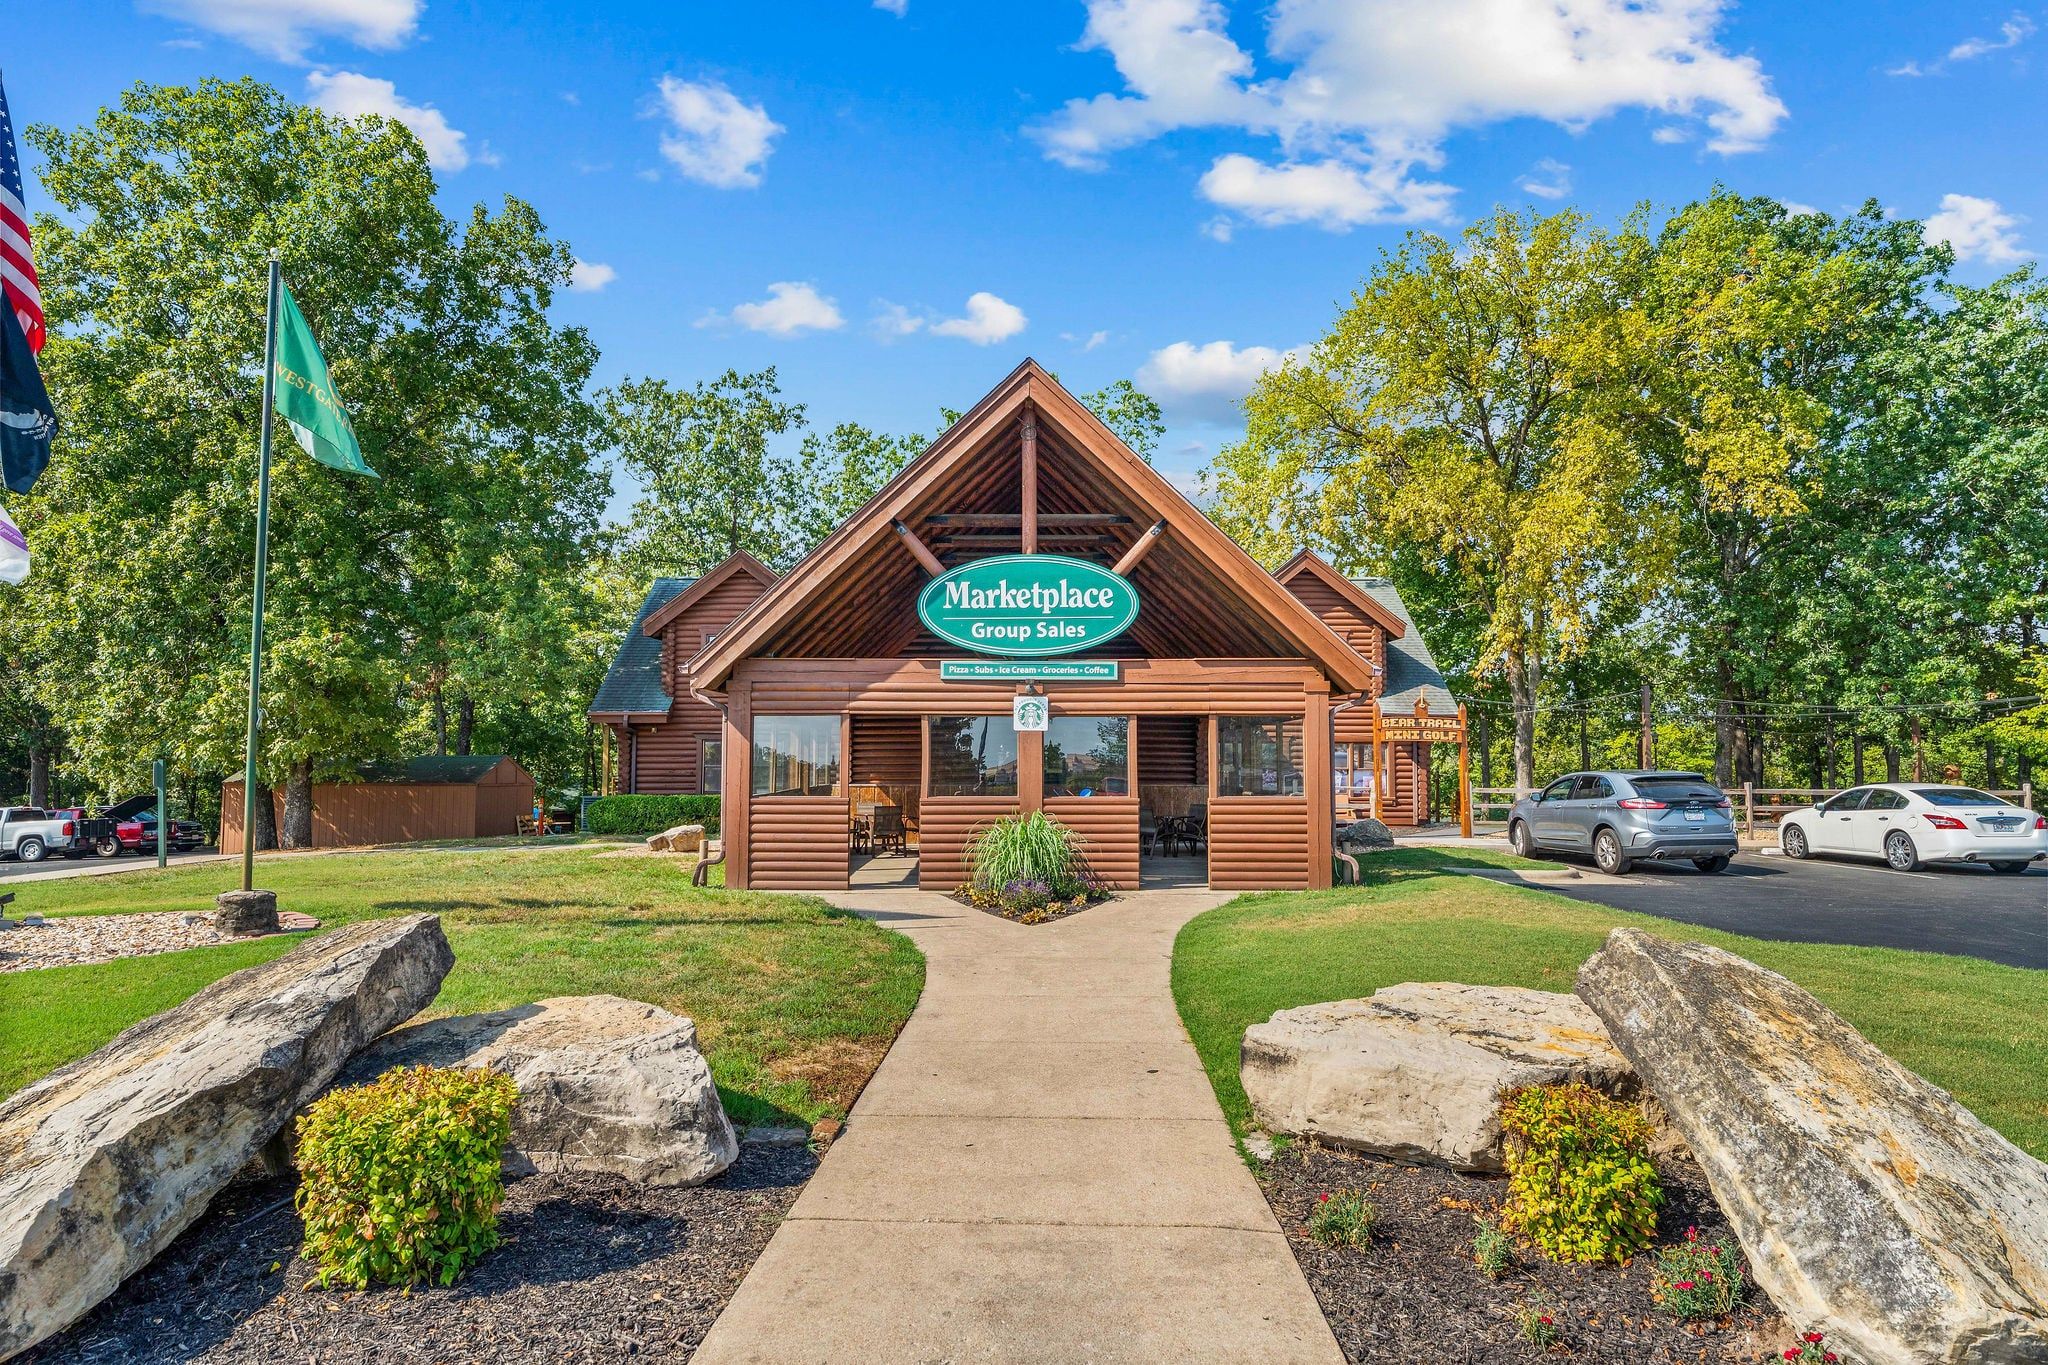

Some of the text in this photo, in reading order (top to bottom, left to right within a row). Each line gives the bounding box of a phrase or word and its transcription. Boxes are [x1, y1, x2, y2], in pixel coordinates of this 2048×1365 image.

[942, 578, 1114, 614] Marketplace
[971, 621, 1086, 642] Group Sales
[948, 665, 1109, 674] Pizza Subs Ice Cream Groceries Coffee
[1381, 718, 1461, 729] BEAR TRAIL
[1385, 730, 1458, 741] MINI GOLF
